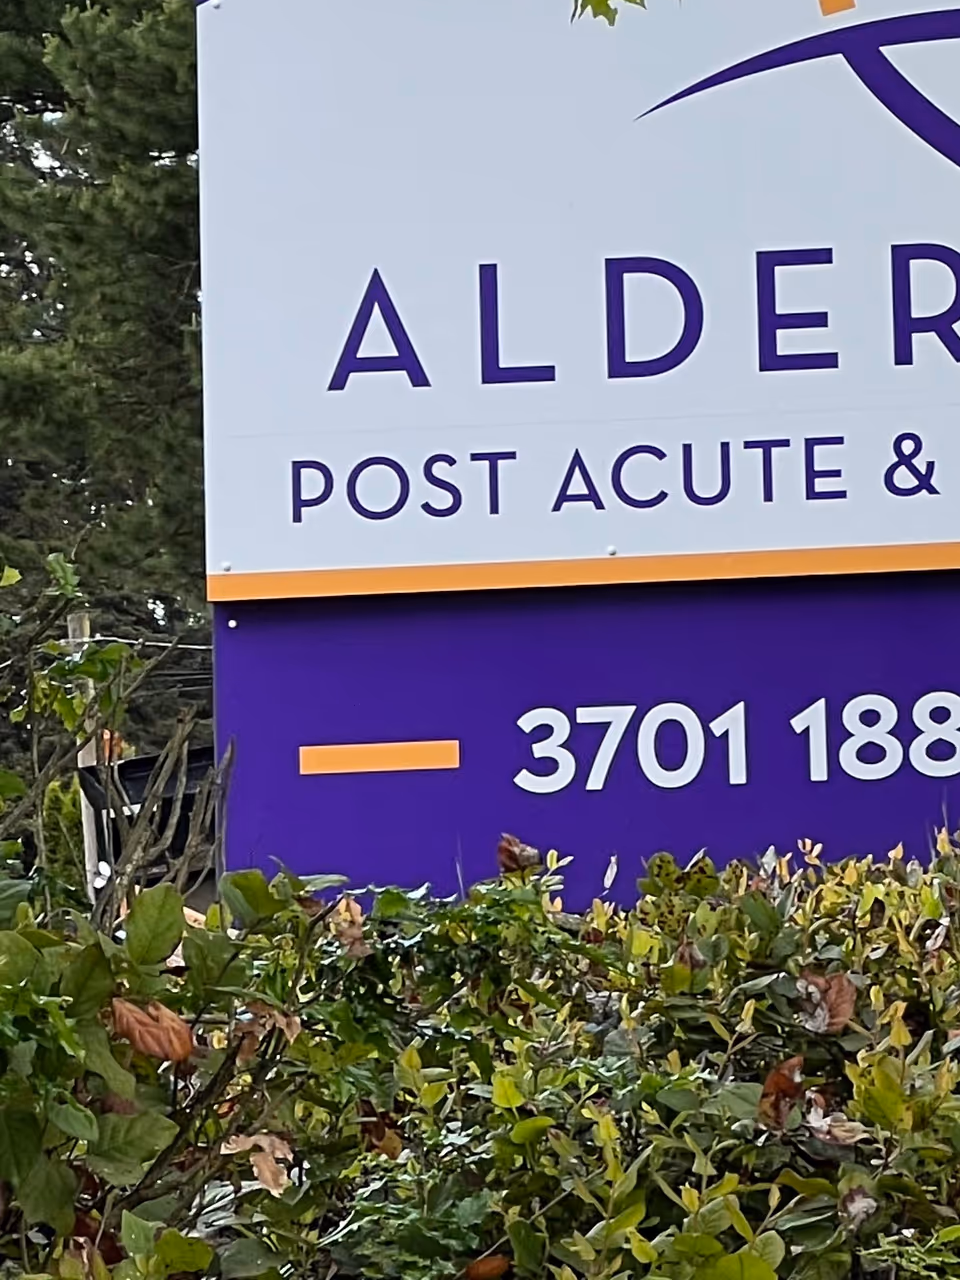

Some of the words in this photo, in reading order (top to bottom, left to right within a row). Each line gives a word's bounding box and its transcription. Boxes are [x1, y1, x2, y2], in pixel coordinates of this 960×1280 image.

[290, 450, 517, 523] POST
[551, 436, 848, 513] ACUTE
[883, 431, 941, 497] &
[512, 700, 749, 795] 3701
